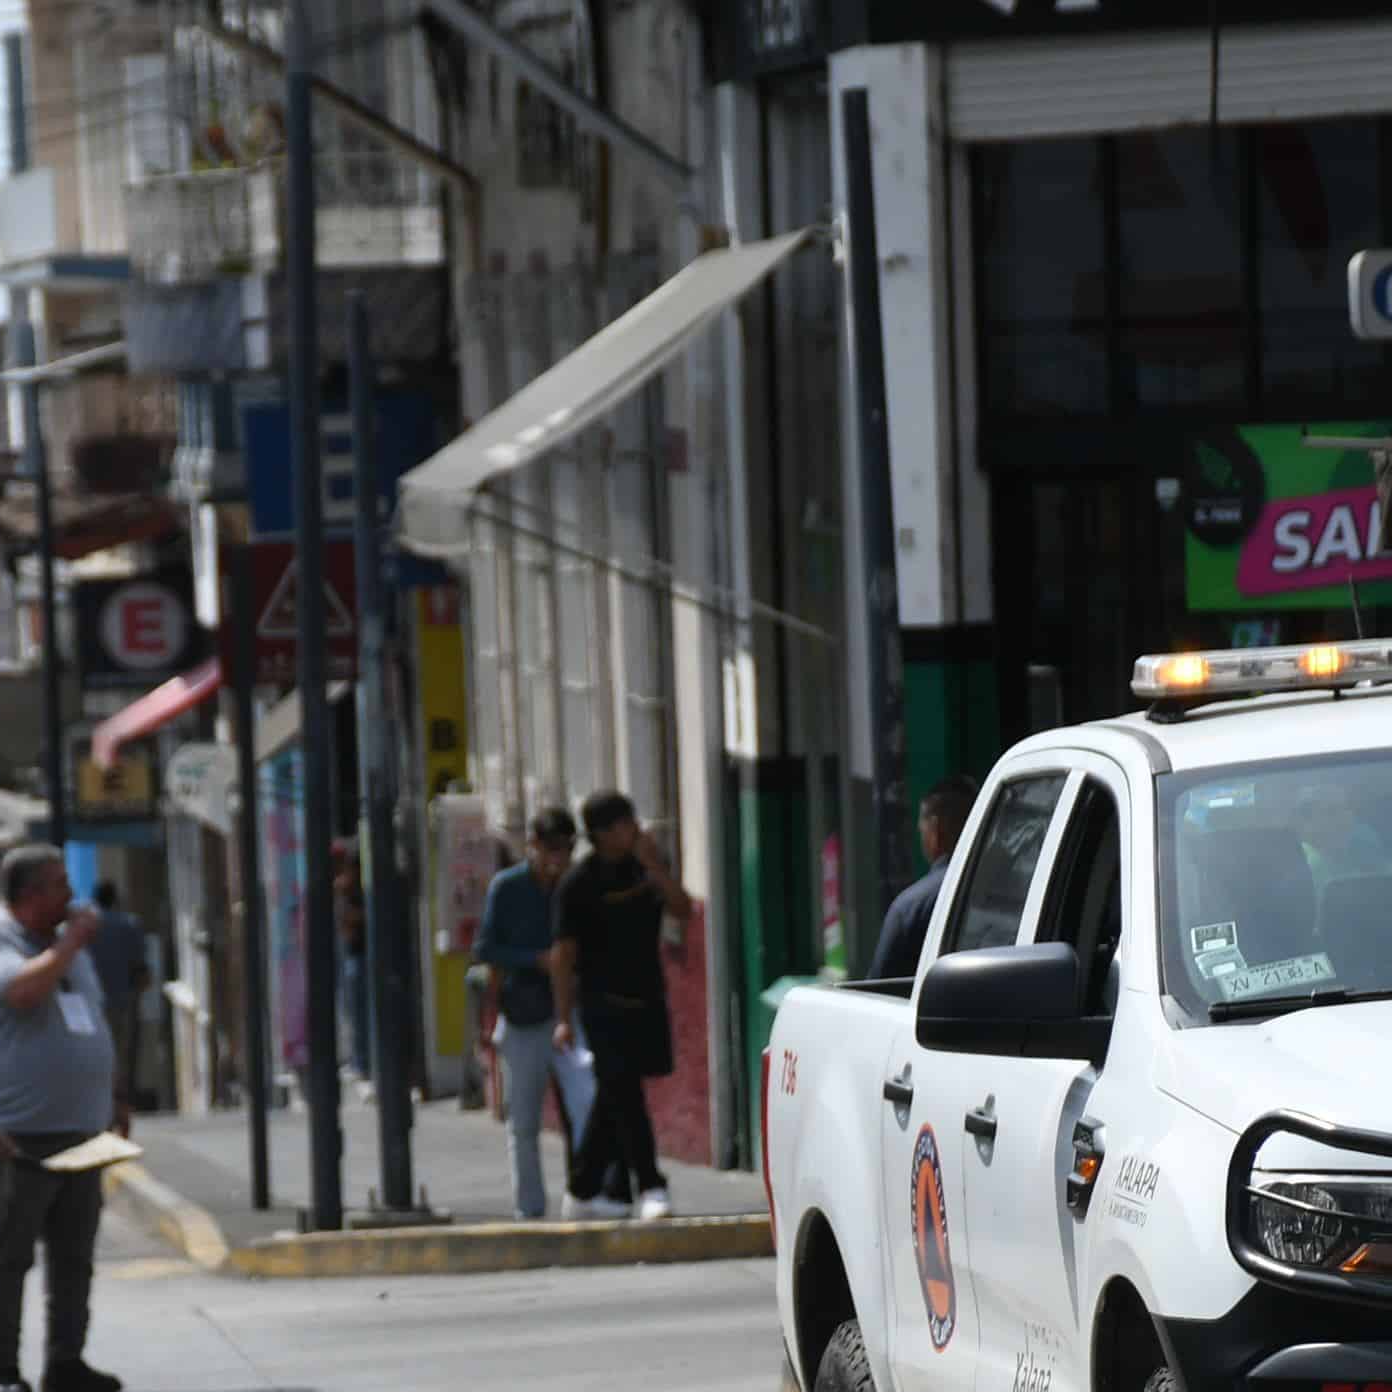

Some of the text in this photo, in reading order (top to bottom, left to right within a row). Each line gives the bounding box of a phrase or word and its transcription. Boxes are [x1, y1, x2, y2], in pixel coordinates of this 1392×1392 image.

[122, 602, 166, 652] E
[781, 1049, 800, 1096] 736
[1115, 1156, 1160, 1200] XALAPA
